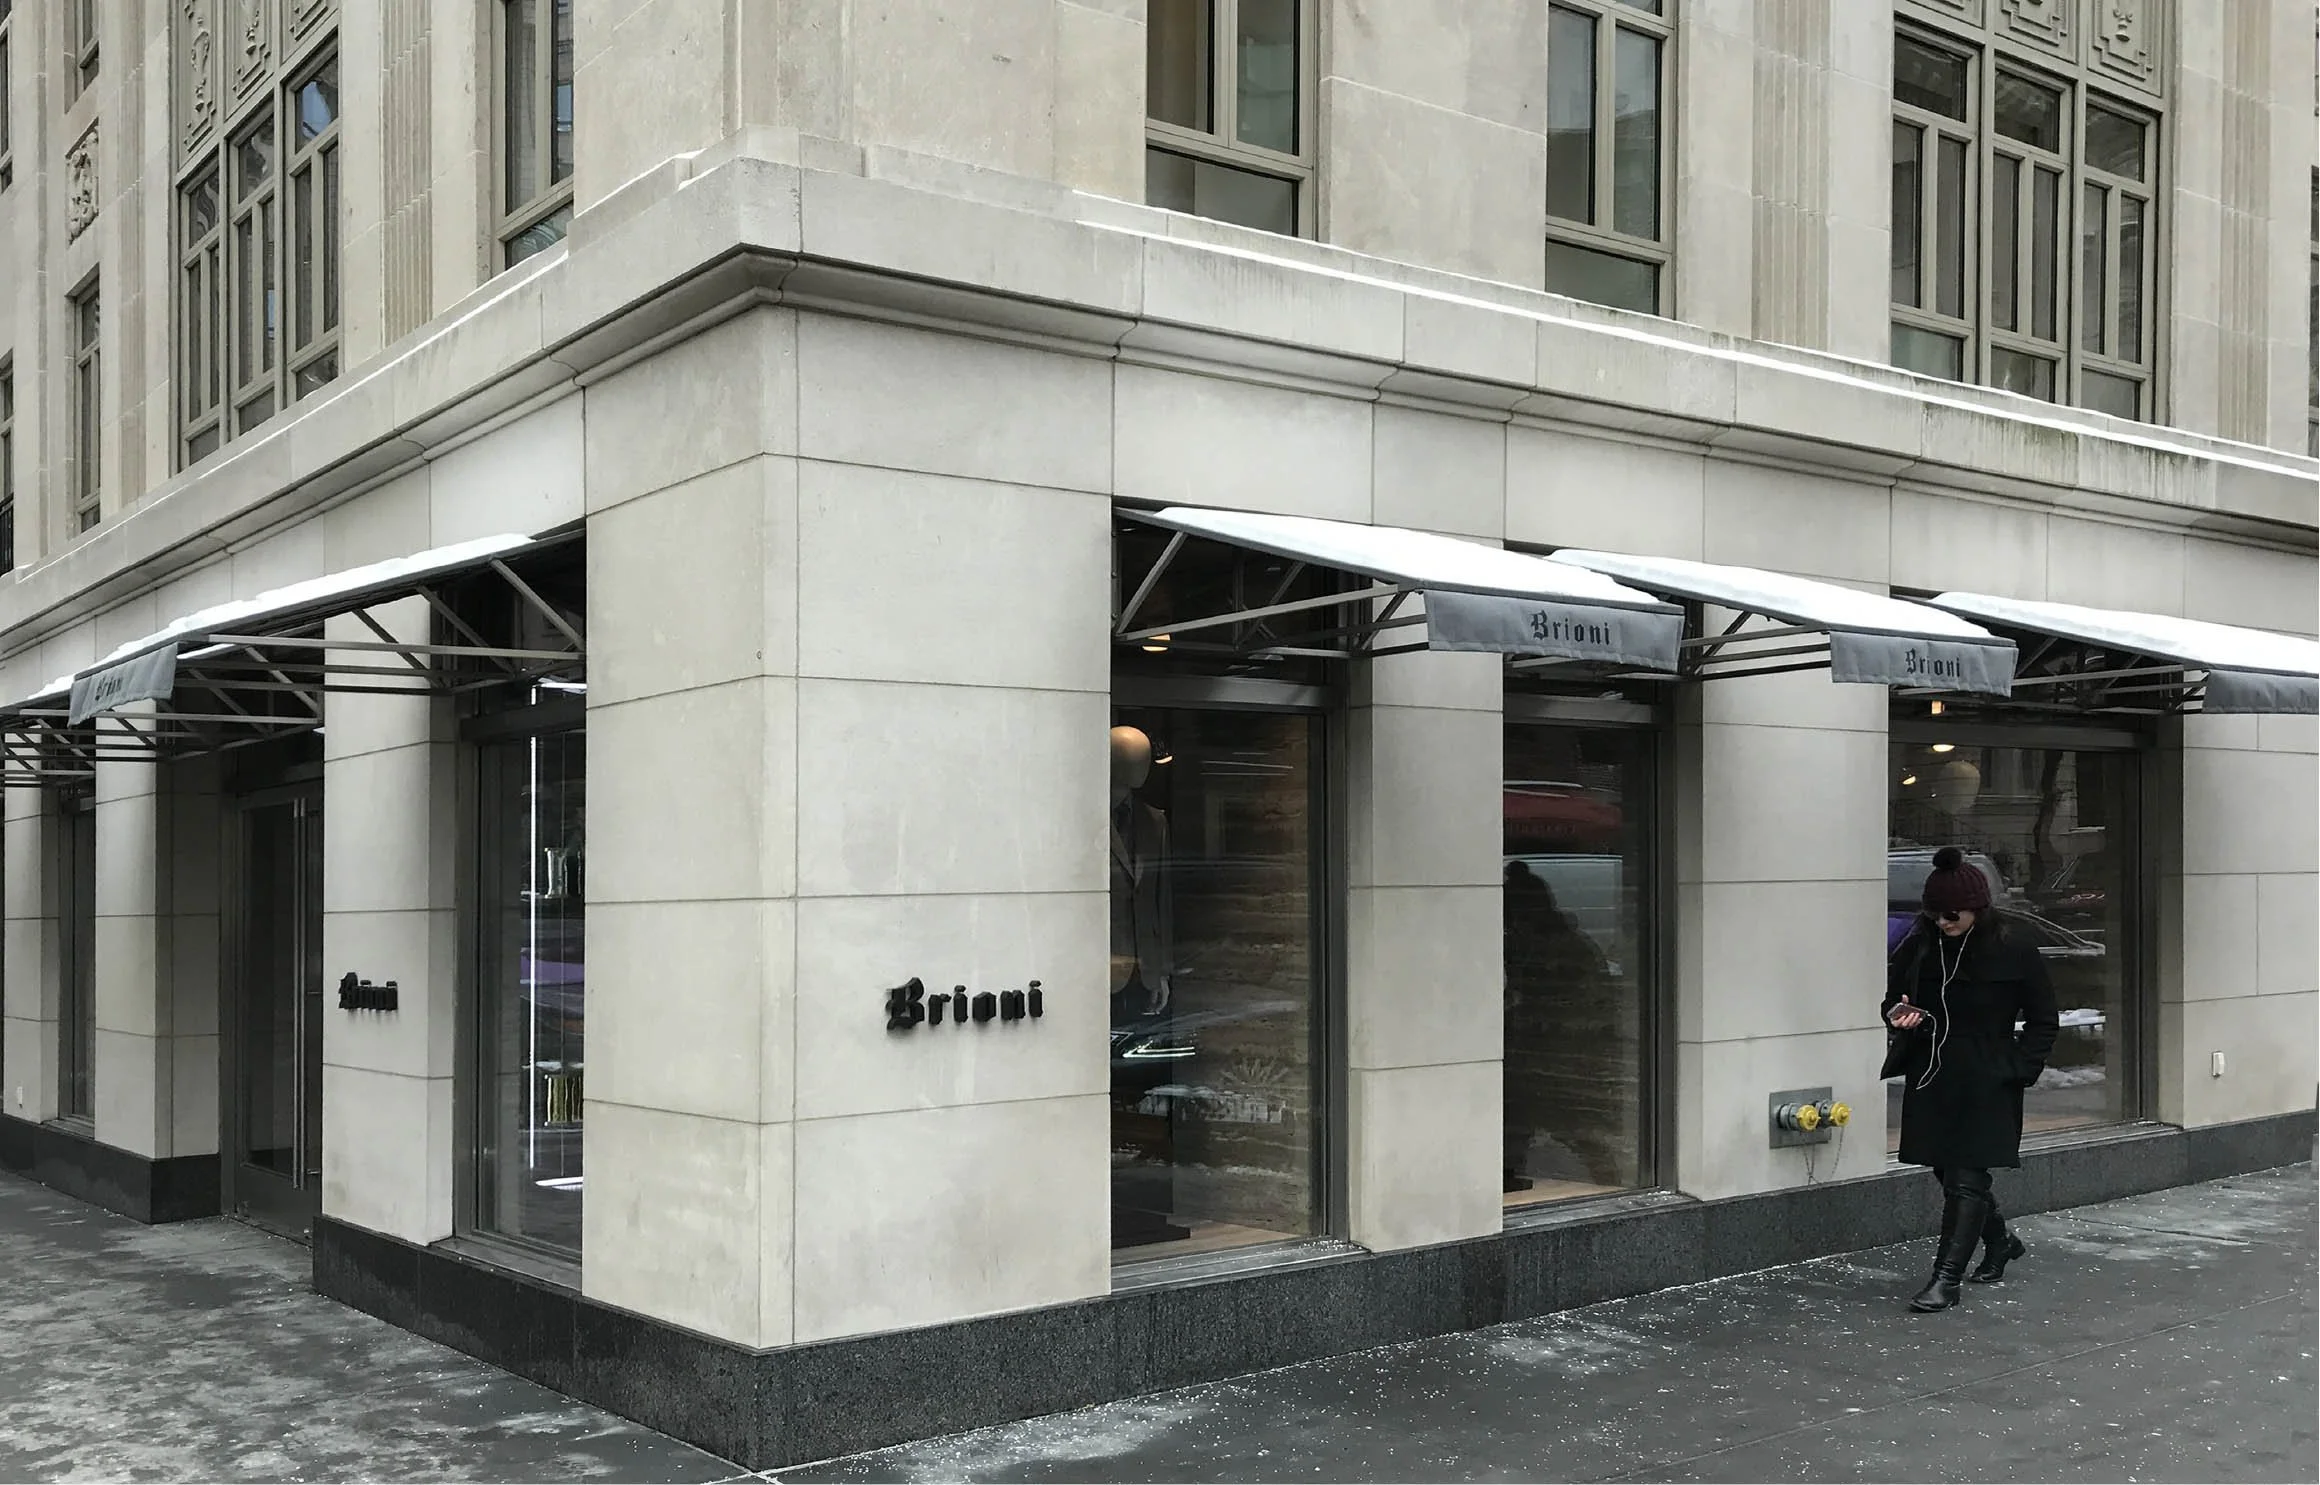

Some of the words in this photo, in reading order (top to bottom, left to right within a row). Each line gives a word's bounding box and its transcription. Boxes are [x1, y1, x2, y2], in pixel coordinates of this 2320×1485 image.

[1530, 610, 1610, 645] Brioni
[1905, 648, 1961, 678] Brioni
[885, 977, 1044, 1031] Brioni
